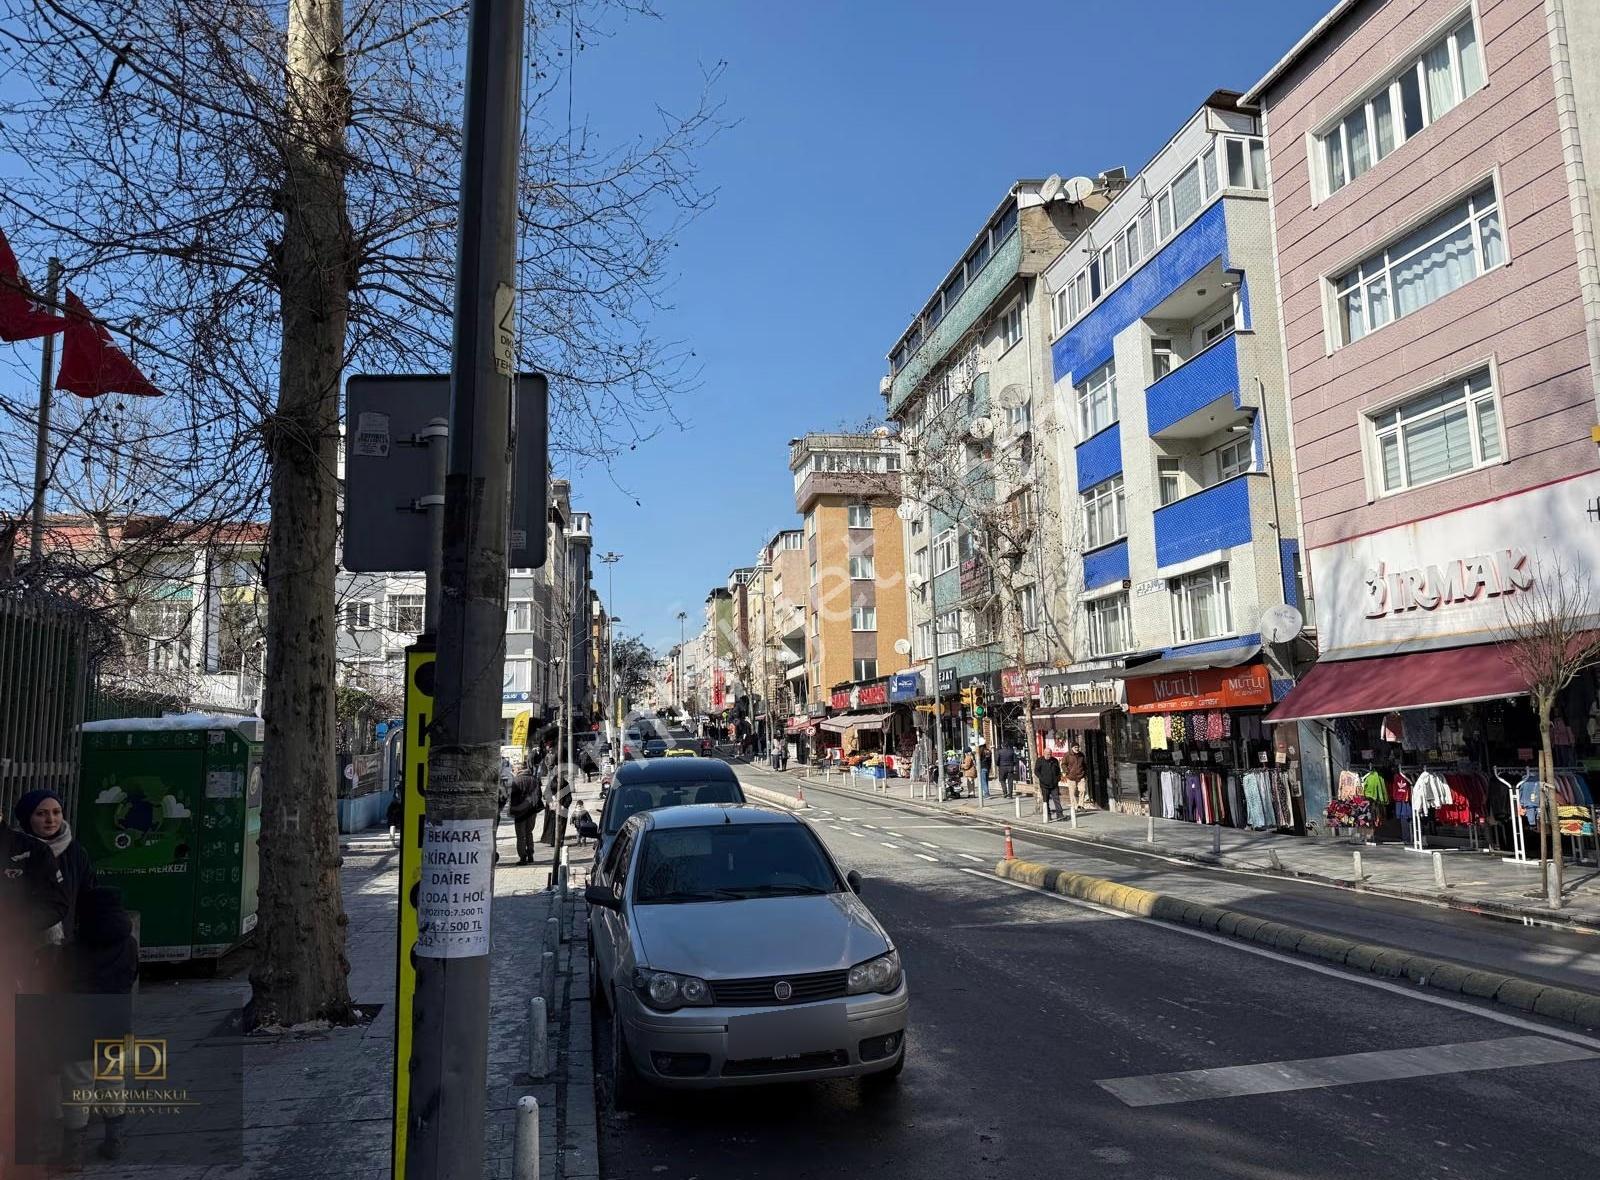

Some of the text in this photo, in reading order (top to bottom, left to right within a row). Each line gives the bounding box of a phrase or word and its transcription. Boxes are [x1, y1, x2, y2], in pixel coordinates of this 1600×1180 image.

[1228, 676, 1265, 690] MUTLU
[428, 830, 481, 843] BEKARA
[427, 849, 479, 865] KİRALIK
[432, 871, 471, 885] DAİRE
[426, 892, 448, 904] ODA
[452, 893, 459, 903] 1
[463, 891, 485, 903] HOL
[477, 907, 484, 915] TL
[472, 920, 482, 930] TL
